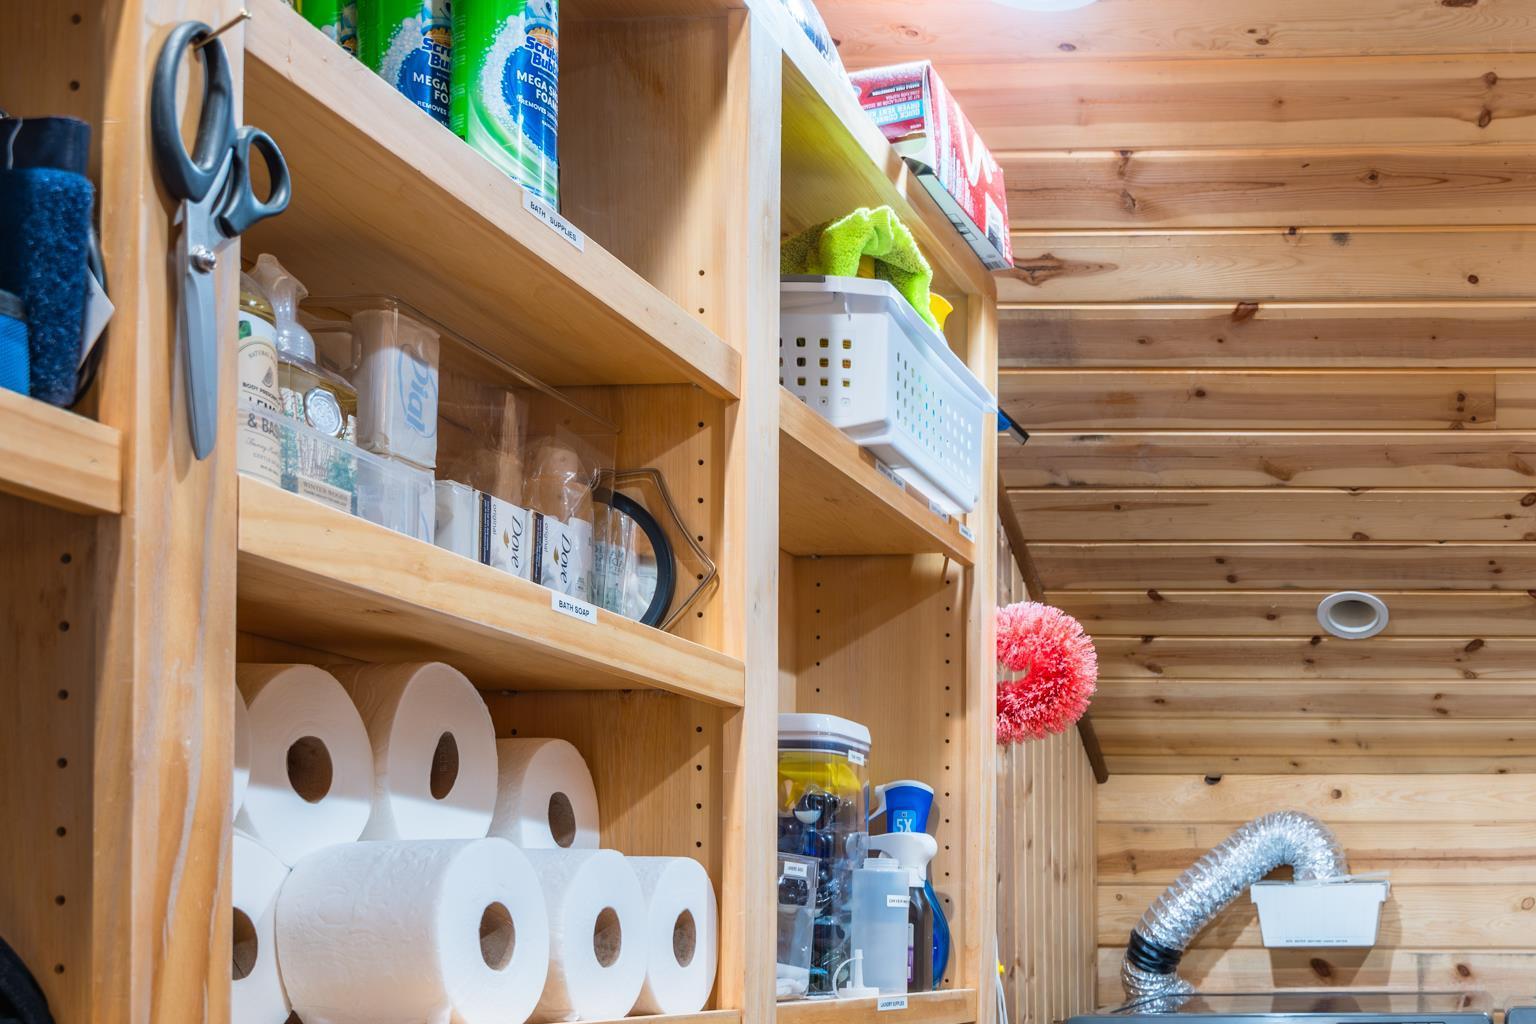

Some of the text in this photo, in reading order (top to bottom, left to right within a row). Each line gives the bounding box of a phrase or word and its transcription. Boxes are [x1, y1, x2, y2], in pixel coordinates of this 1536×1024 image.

[413, 72, 448, 94] MEGA
[516, 70, 547, 91] MEGA
[530, 201, 577, 242] BATH SUPPLIES
[511, 515, 524, 569] Dove
[562, 532, 572, 585] Dove
[558, 599, 590, 617] BATH SOAP
